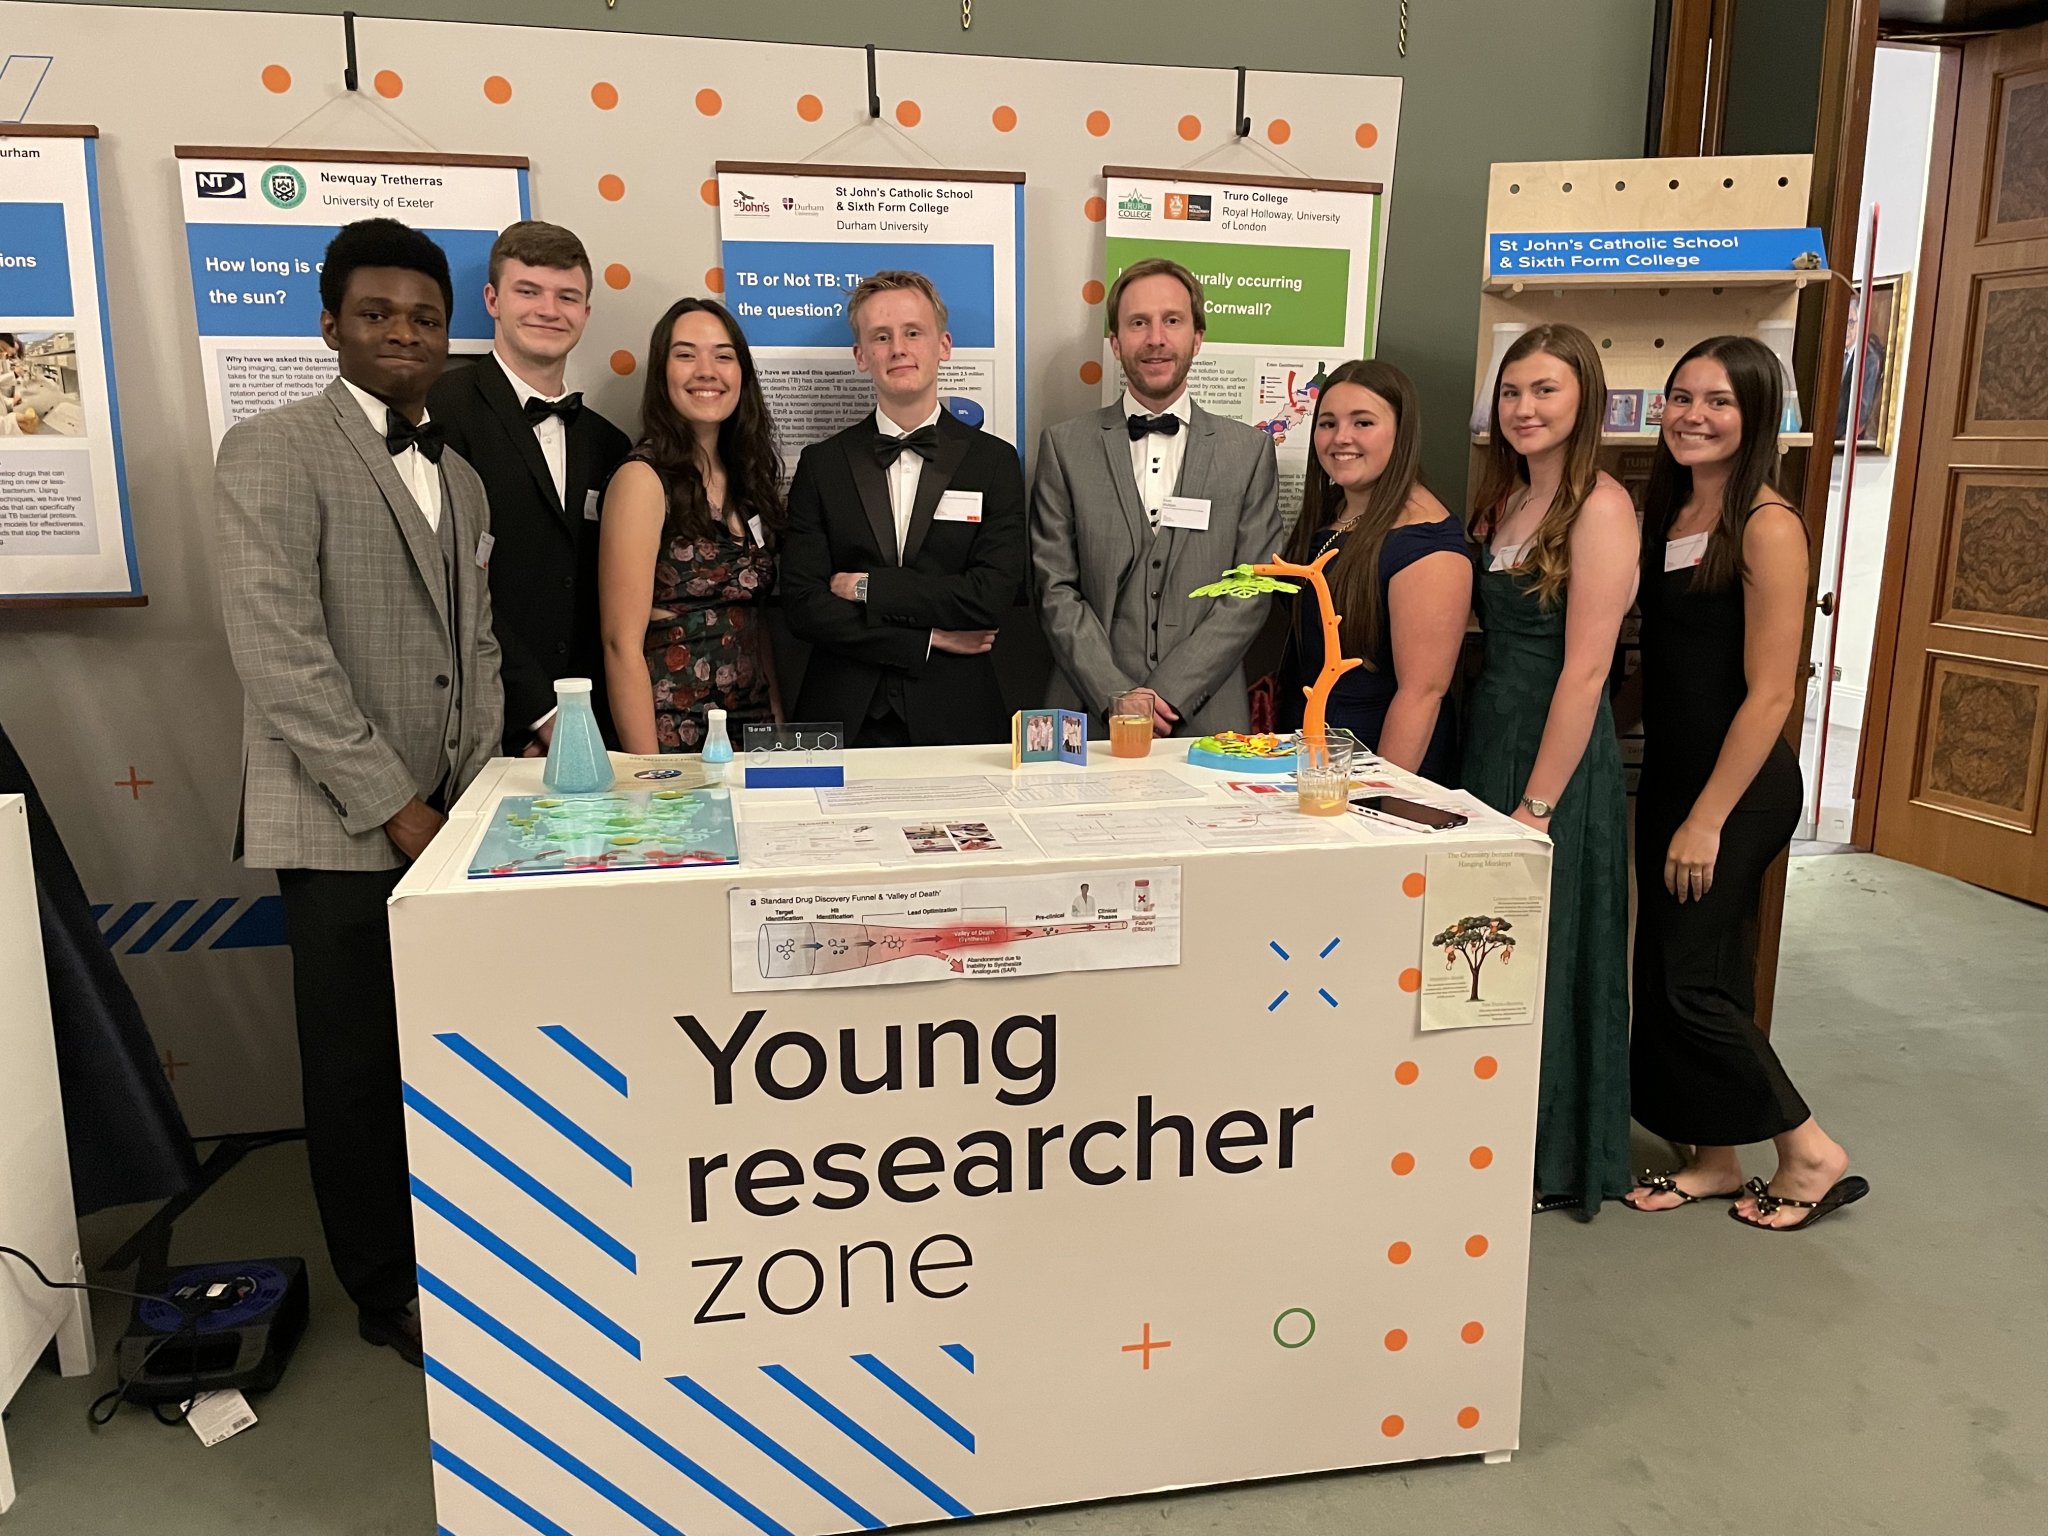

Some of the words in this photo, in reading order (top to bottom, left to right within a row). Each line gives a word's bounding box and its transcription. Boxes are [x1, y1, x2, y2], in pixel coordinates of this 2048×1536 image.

[0, 148, 40, 158] urham
[199, 173, 227, 188] NT
[320, 172, 377, 186] Newquay
[381, 174, 443, 187] Tretherras
[835, 187, 847, 198] St
[850, 187, 886, 199] John's
[889, 187, 933, 199] Catholic
[936, 188, 973, 200] School
[1223, 191, 1249, 202] Truro
[1252, 192, 1288, 204] College
[323, 195, 380, 208] University
[383, 197, 395, 207] of
[398, 198, 434, 208] Exeter
[740, 202, 770, 212] John's
[794, 203, 824, 211] Durham
[836, 202, 844, 213] &
[847, 201, 875, 213] Sixth
[878, 202, 906, 213] Form
[909, 202, 949, 215] College
[1118, 210, 1151, 218] COLLEGE
[1222, 207, 1248, 218] Royal
[1251, 208, 1293, 221] Holloway,
[1296, 211, 1341, 224] University
[836, 220, 877, 231] Durham
[879, 221, 929, 233] University
[1221, 221, 1231, 231] of
[1233, 221, 1266, 232] London
[1499, 240, 1519, 251] St
[1523, 238, 1584, 251] John's
[1589, 237, 1667, 250] Catholic
[1672, 236, 1739, 249] School
[206, 257, 245, 271] How
[251, 258, 290, 276] long
[295, 258, 310, 272] is
[1499, 257, 1513, 268] &
[1518, 255, 1565, 267] Sixth
[1571, 255, 1620, 267] Form
[1625, 254, 1700, 268] College
[736, 272, 759, 286] TB
[763, 275, 779, 287] or
[783, 273, 810, 287] Not
[814, 274, 841, 287] TB:
[845, 274, 864, 287] Th
[1193, 272, 1234, 289] urally
[1237, 276, 1303, 292] occurring
[209, 290, 238, 304] the
[243, 290, 287, 304] sun?
[738, 302, 762, 316] the
[766, 304, 843, 318] question?
[1203, 300, 1272, 316] Cornwall?
[760, 897, 794, 905] Standard
[795, 896, 813, 905] Drug
[815, 894, 850, 904] Discovery
[878, 893, 884, 901] &
[910, 891, 918, 899] of
[922, 907, 957, 915] Optimization
[673, 1009, 1058, 1106] Young
[688, 1095, 1315, 1223] researcher
[692, 1233, 973, 1324] zone
